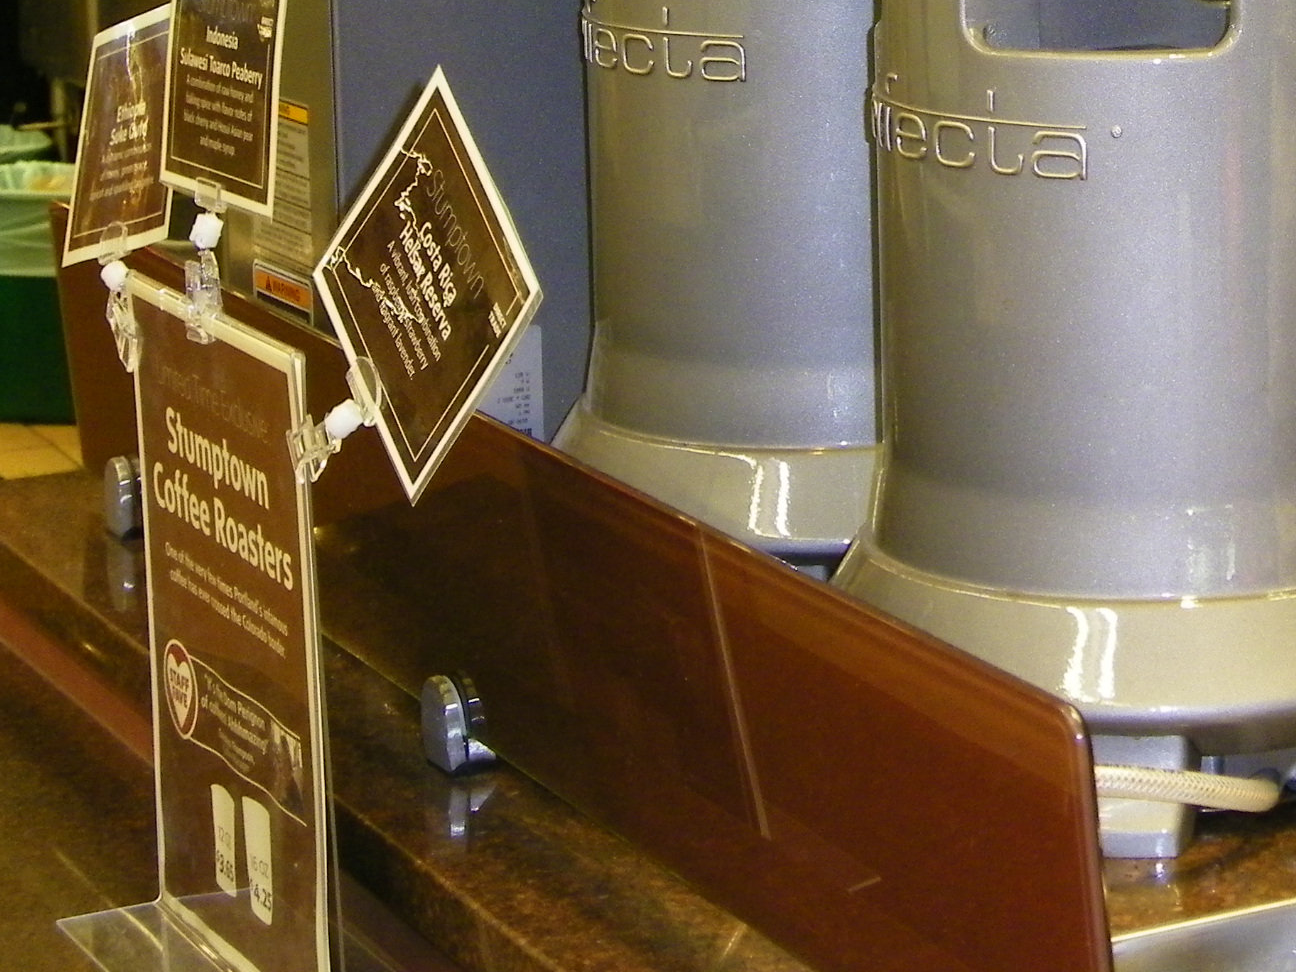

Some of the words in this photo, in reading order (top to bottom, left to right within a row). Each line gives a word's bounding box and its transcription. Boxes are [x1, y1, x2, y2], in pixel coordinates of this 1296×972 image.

[206, 25, 238, 50] Indonesia
[231, 61, 263, 90] Peaberry
[387, 240, 395, 252] A
[399, 220, 426, 277] Helsar
[420, 271, 452, 341] Reserva
[420, 221, 443, 273] Costa
[438, 262, 457, 308] Rica
[427, 169, 484, 299] Stumptown
[380, 263, 391, 275] of
[403, 316, 429, 371] strawberry
[395, 332, 415, 381] lavender.
[165, 407, 270, 510] Stumptown
[153, 462, 210, 537] Coffee
[213, 497, 293, 591] Roasters
